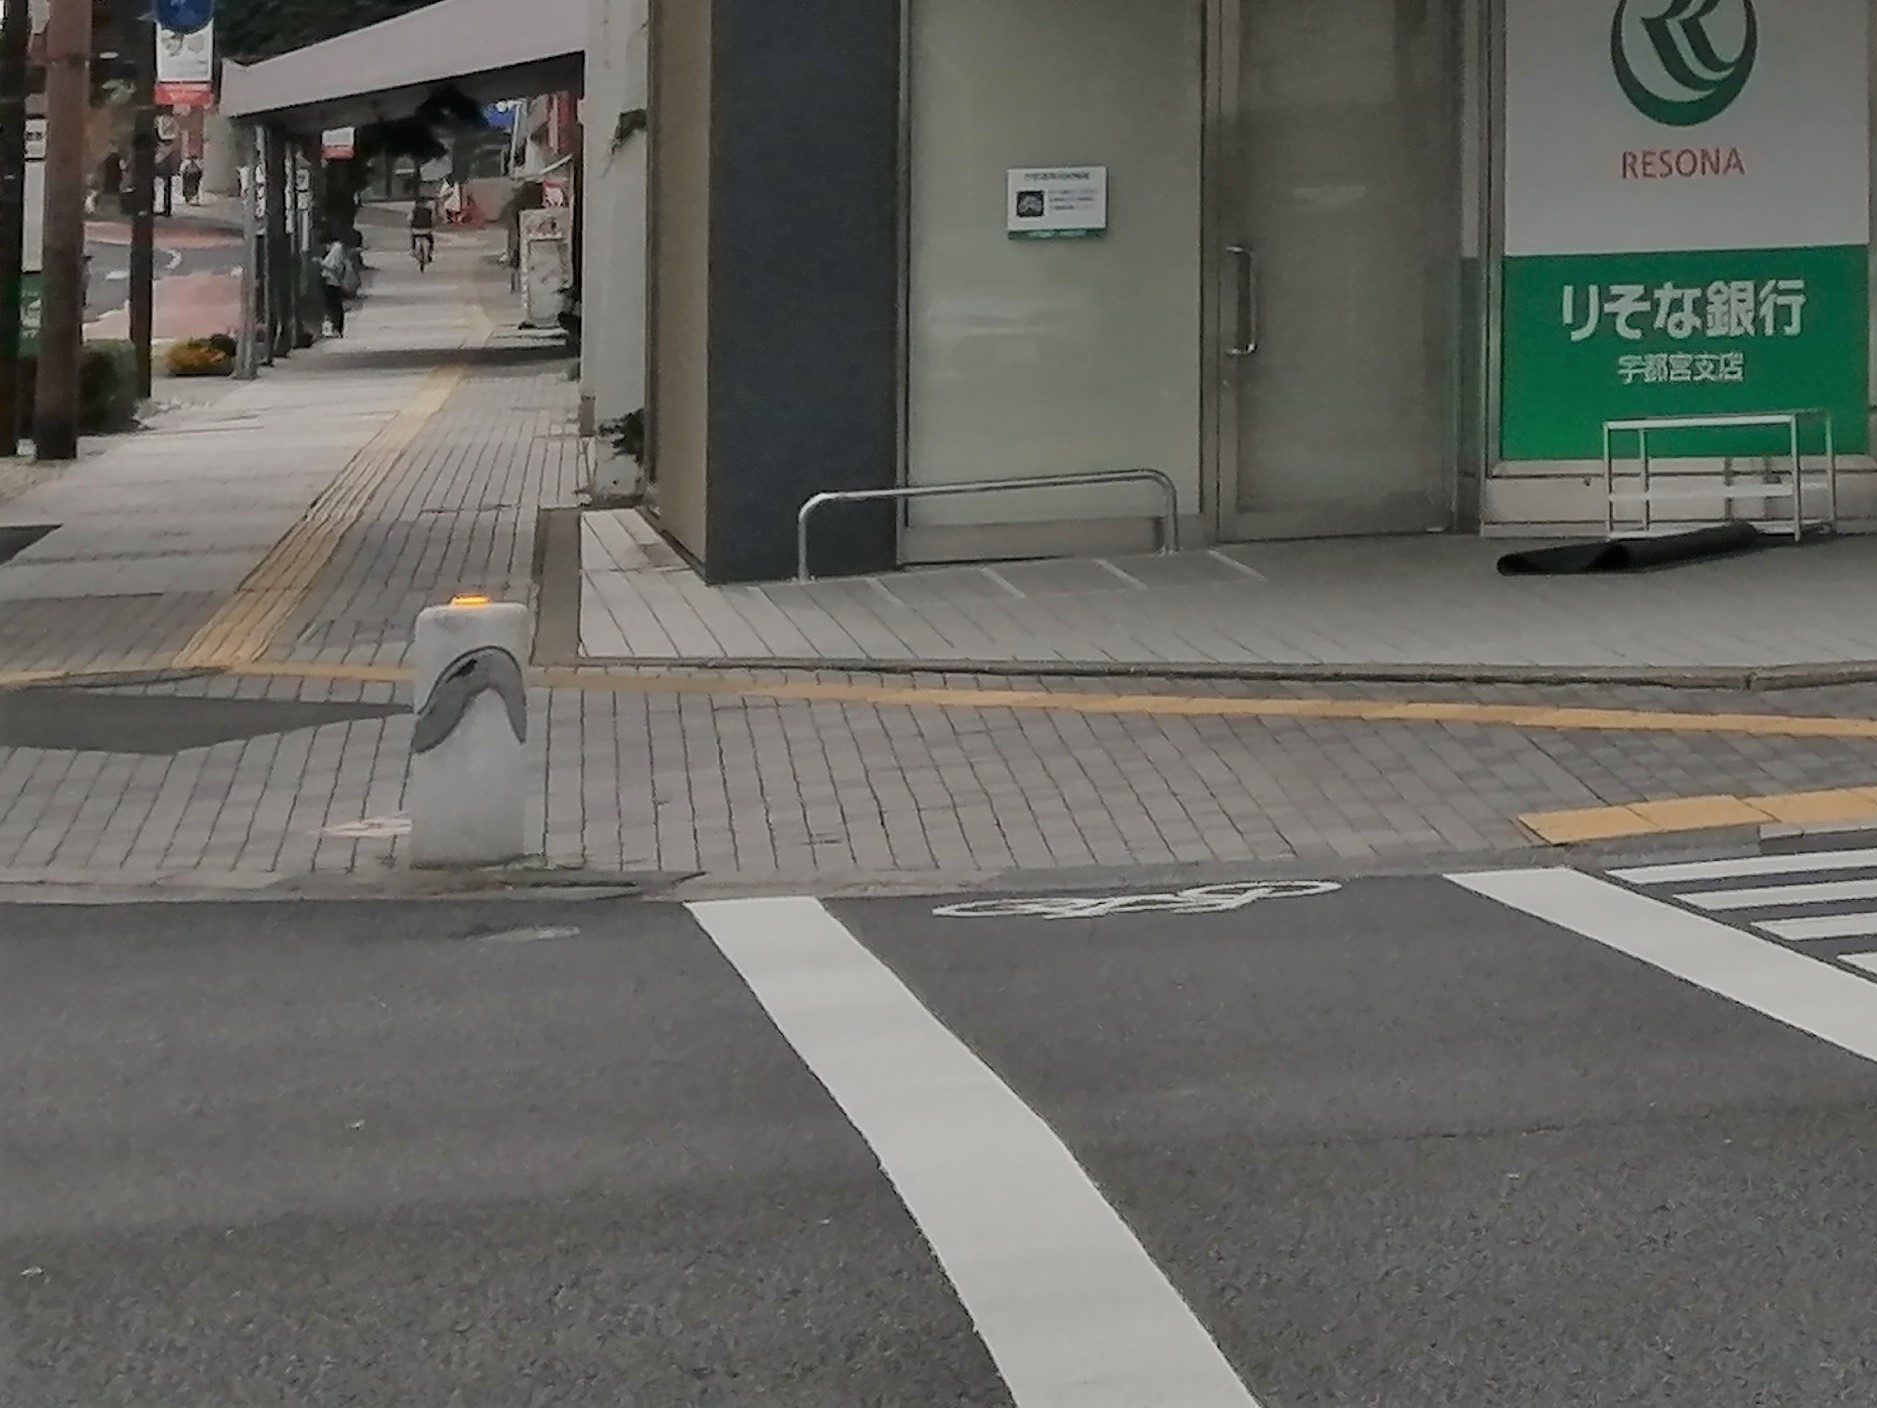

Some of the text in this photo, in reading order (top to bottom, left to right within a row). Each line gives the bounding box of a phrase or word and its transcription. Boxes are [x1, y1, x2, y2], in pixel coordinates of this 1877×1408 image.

[1621, 146, 1746, 180] RESONA
[1561, 278, 1807, 342] りそな銀行
[1616, 350, 1745, 384] 宇都宮支店
